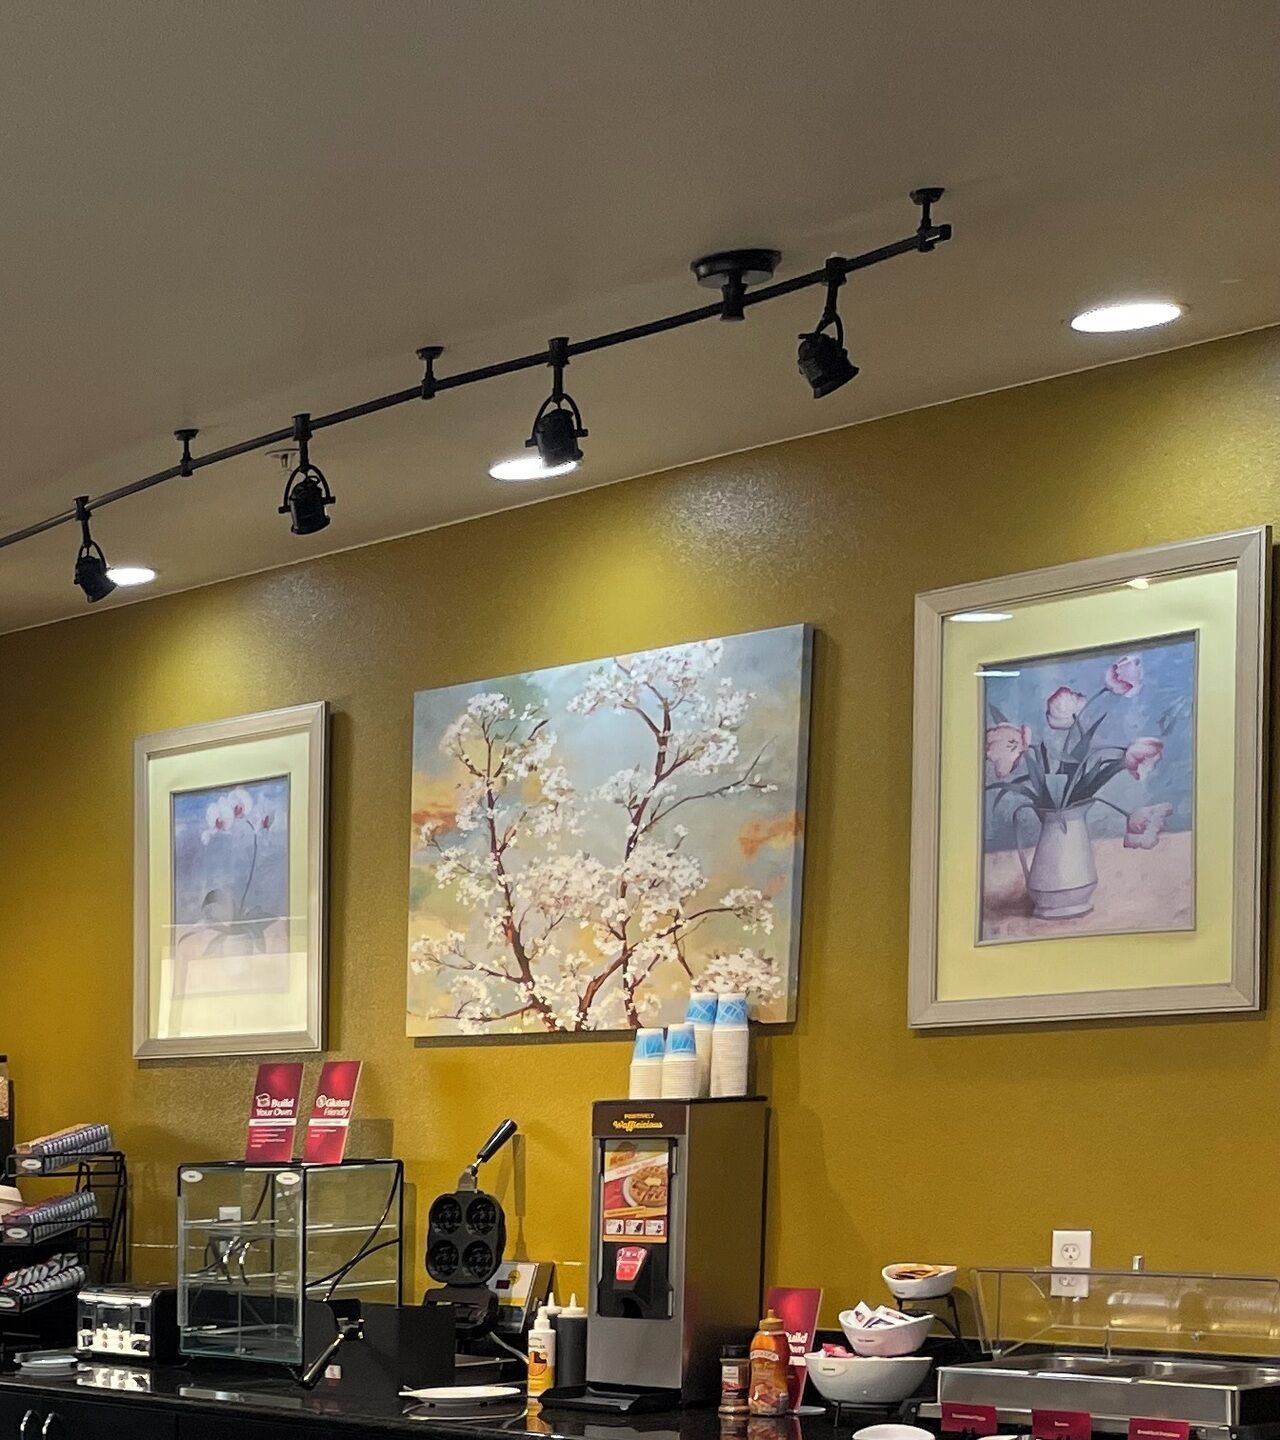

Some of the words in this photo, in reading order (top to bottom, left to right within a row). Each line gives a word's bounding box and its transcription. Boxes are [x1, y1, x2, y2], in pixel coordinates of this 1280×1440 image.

[270, 1098, 295, 1108] Build
[325, 1098, 350, 1108] Gluten
[256, 1108, 273, 1117] Your
[273, 1108, 293, 1116] Own
[324, 1107, 349, 1118] Friendly
[785, 1331, 809, 1344] uild
[789, 1343, 806, 1354] wn
